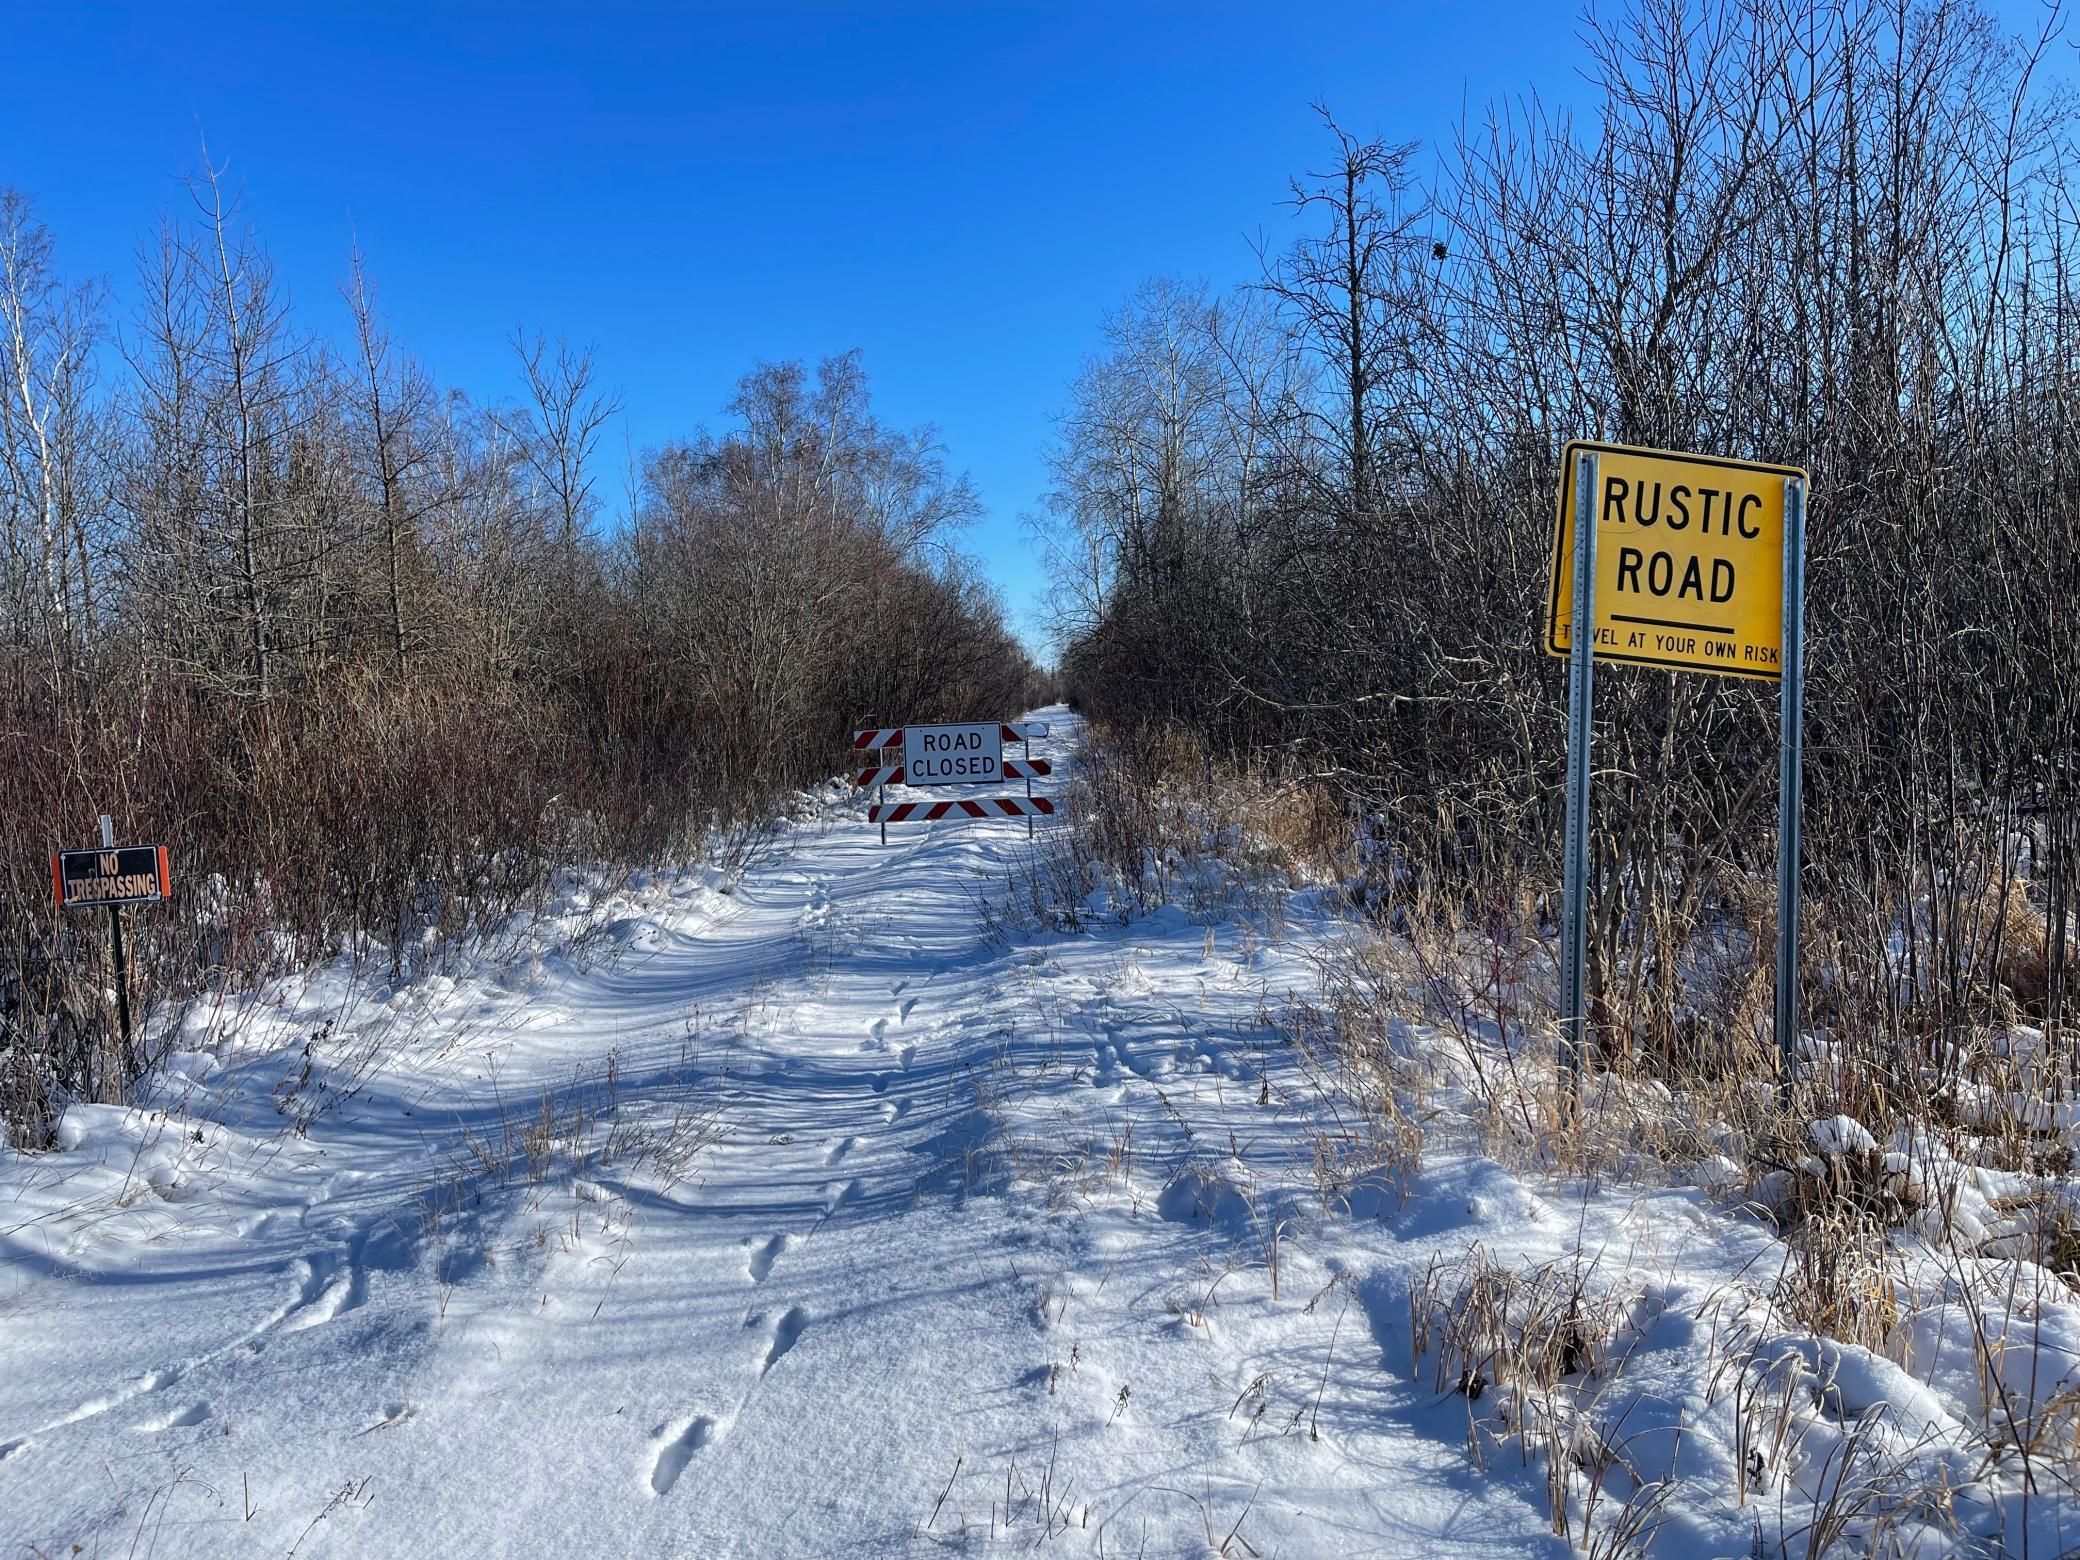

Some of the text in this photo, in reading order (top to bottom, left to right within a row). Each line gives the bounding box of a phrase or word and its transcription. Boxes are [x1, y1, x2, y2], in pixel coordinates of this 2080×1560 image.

[1602, 476, 1763, 539] RUSTIC
[1617, 547, 1735, 603] ROAD
[1562, 624, 1779, 664] TVEL AT YOUR OWN RISK
[924, 733, 982, 752] ROAD
[912, 757, 995, 777] CLOSED
[99, 853, 119, 876] NO
[67, 873, 156, 901] TRESPASSING
